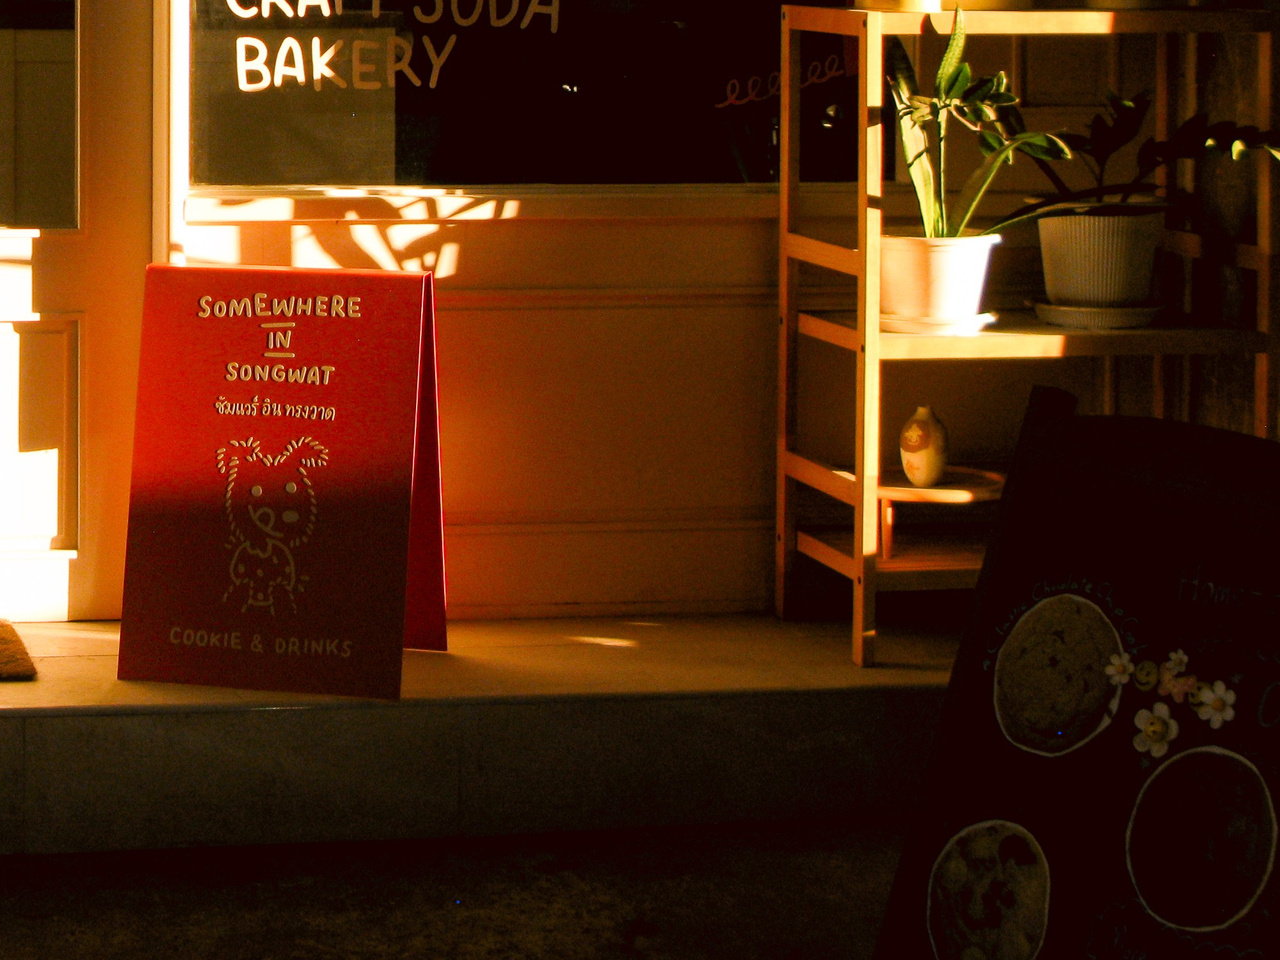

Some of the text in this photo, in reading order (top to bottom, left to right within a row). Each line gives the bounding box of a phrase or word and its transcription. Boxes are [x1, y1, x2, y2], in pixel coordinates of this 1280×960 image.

[236, 34, 457, 92] BAKERY
[198, 292, 361, 318] SOMEWHERE
[268, 330, 291, 349] IN
[225, 362, 335, 385] SONGWAT
[262, 398, 281, 416] อิน
[285, 403, 336, 421] ทรงวาด
[170, 627, 353, 658] COOKIE & DRINKS
